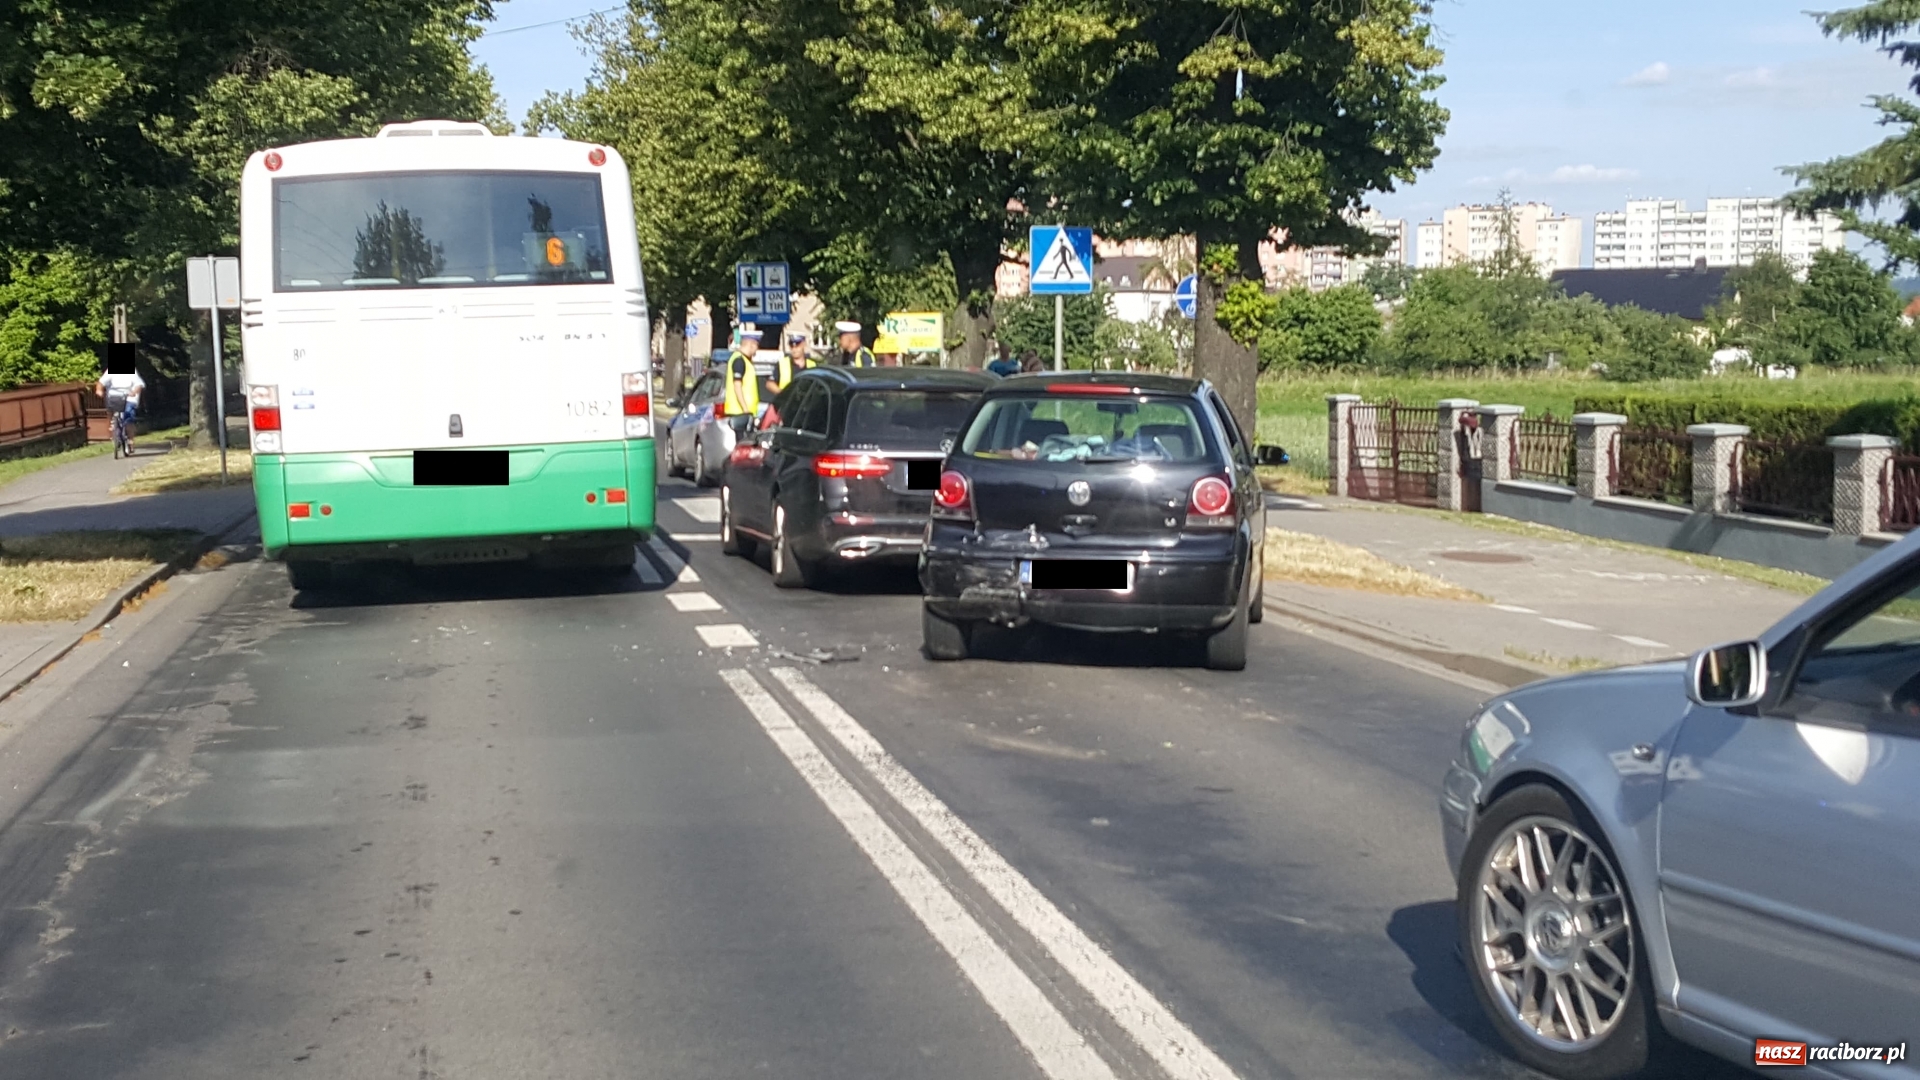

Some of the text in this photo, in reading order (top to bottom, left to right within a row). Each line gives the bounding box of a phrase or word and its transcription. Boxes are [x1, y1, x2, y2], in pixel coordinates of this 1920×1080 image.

[546, 237, 565, 267] 6
[768, 292, 783, 300] ON
[566, 400, 612, 416] 1082
